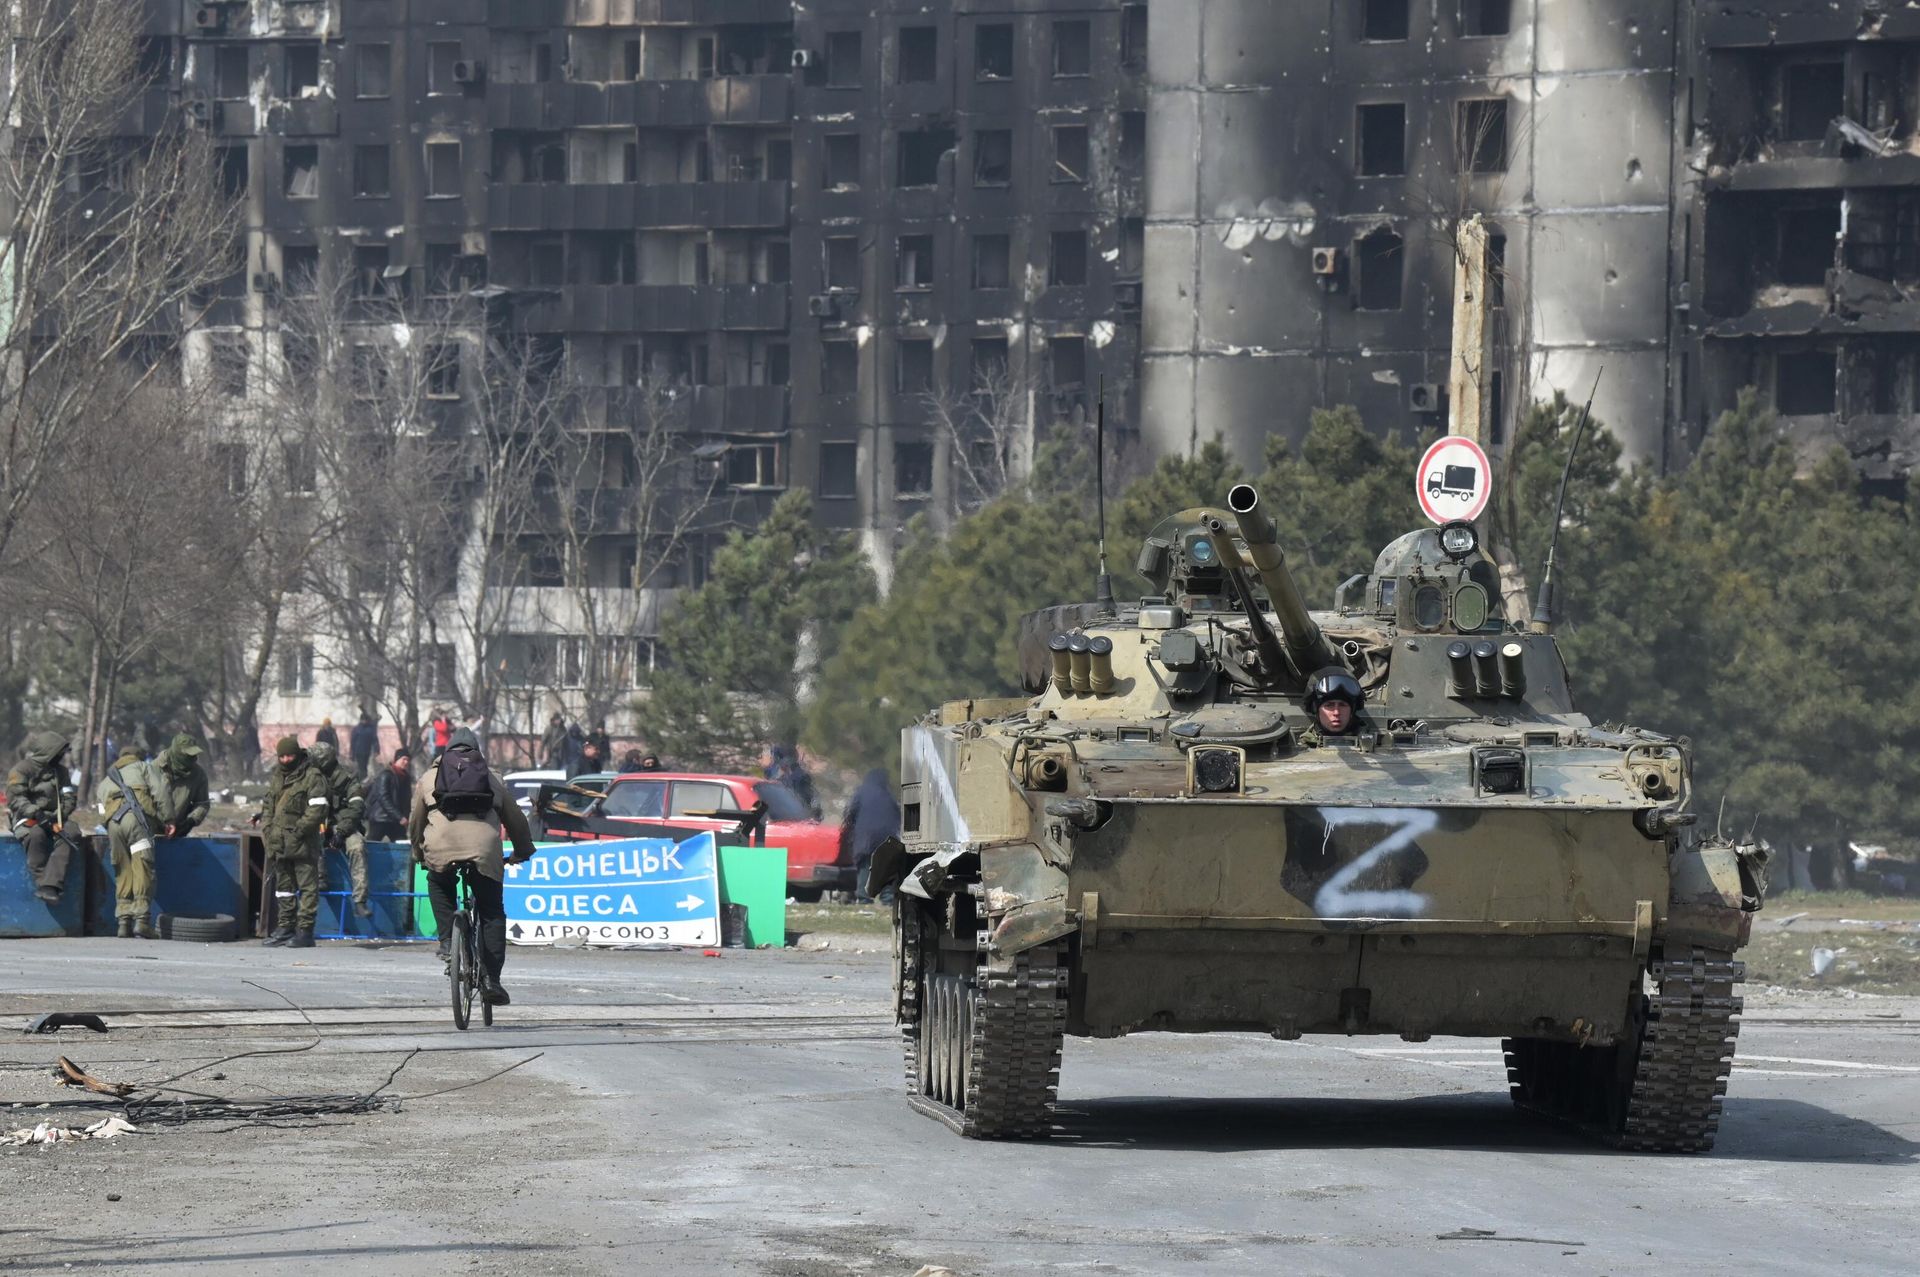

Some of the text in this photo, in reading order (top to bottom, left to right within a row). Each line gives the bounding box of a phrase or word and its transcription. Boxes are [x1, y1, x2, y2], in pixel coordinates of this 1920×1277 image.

[529, 846, 684, 881] ДОНЕЦЬК
[1314, 807, 1438, 917] Z
[525, 894, 639, 917] ОДЕСА
[534, 925, 670, 940] АГРО-СОЮЗ
